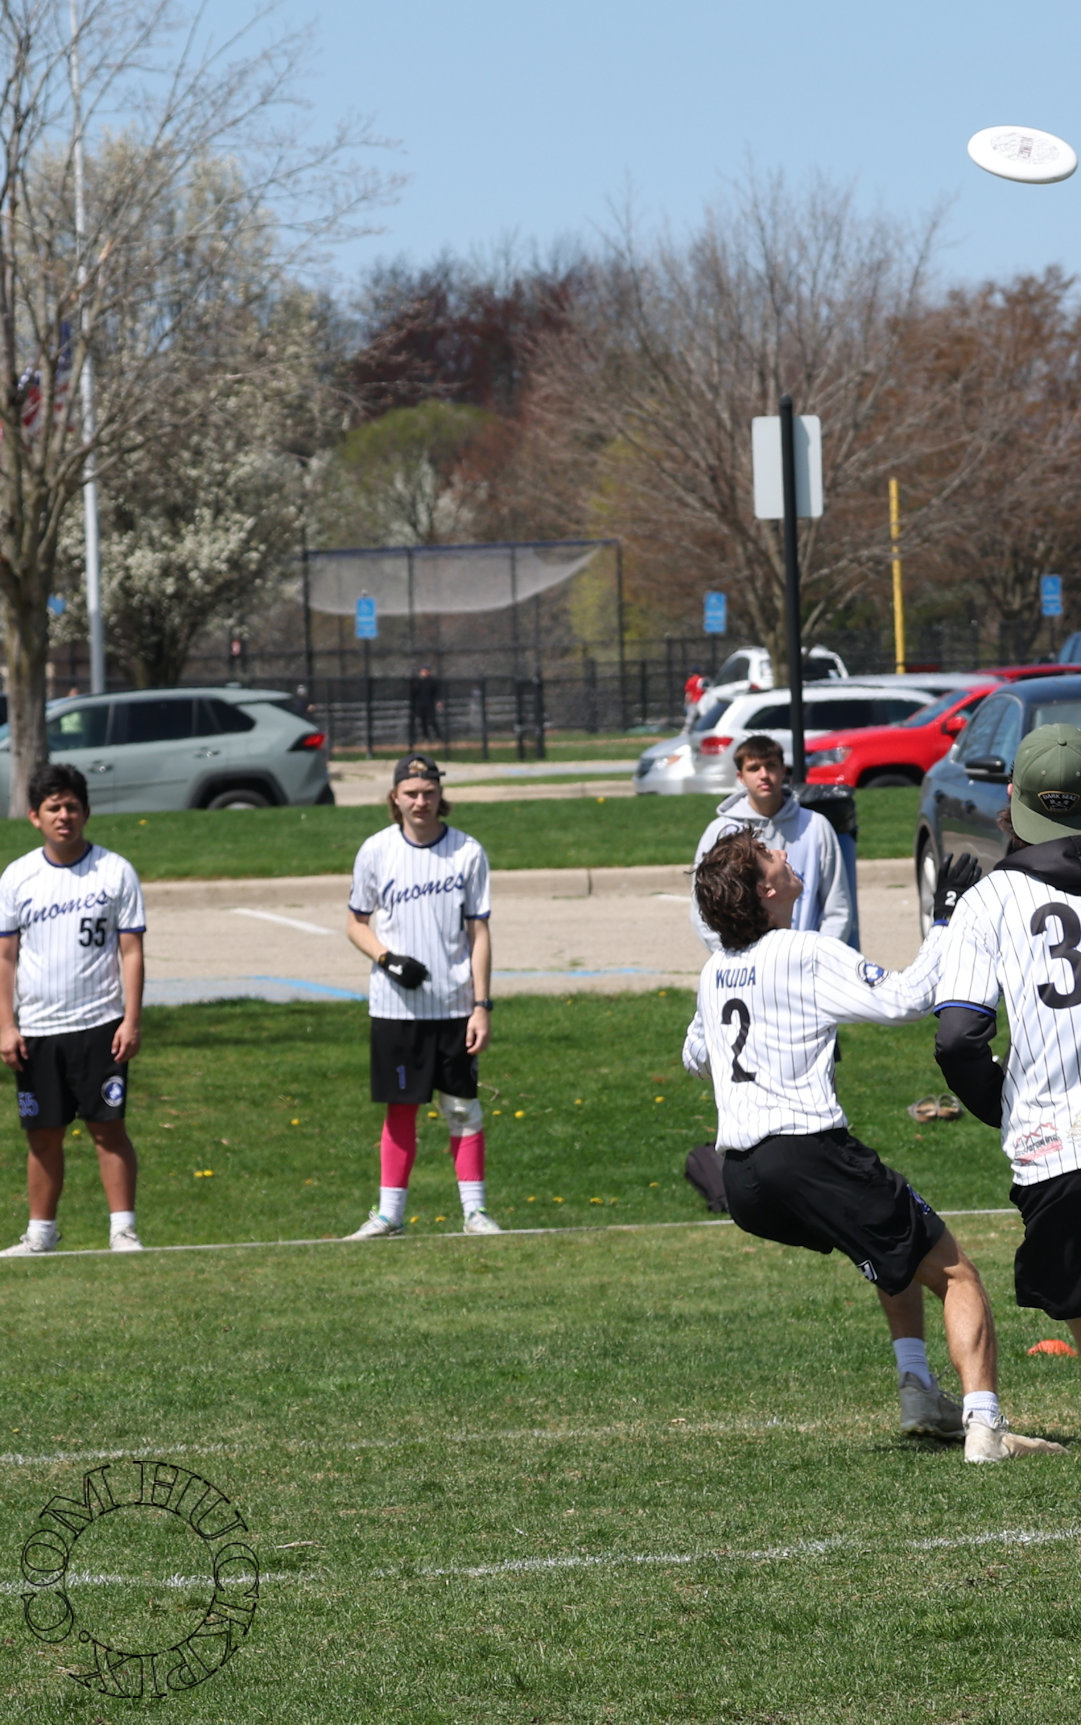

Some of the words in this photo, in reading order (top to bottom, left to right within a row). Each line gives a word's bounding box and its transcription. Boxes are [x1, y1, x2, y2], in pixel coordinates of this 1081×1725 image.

[381, 872, 466, 920] Gnomes
[944, 891, 957, 906] 2
[79, 917, 107, 947] 55
[721, 998, 757, 1083] 2
[395, 1064, 406, 1090] 1
[18, 1091, 39, 1117] 55
